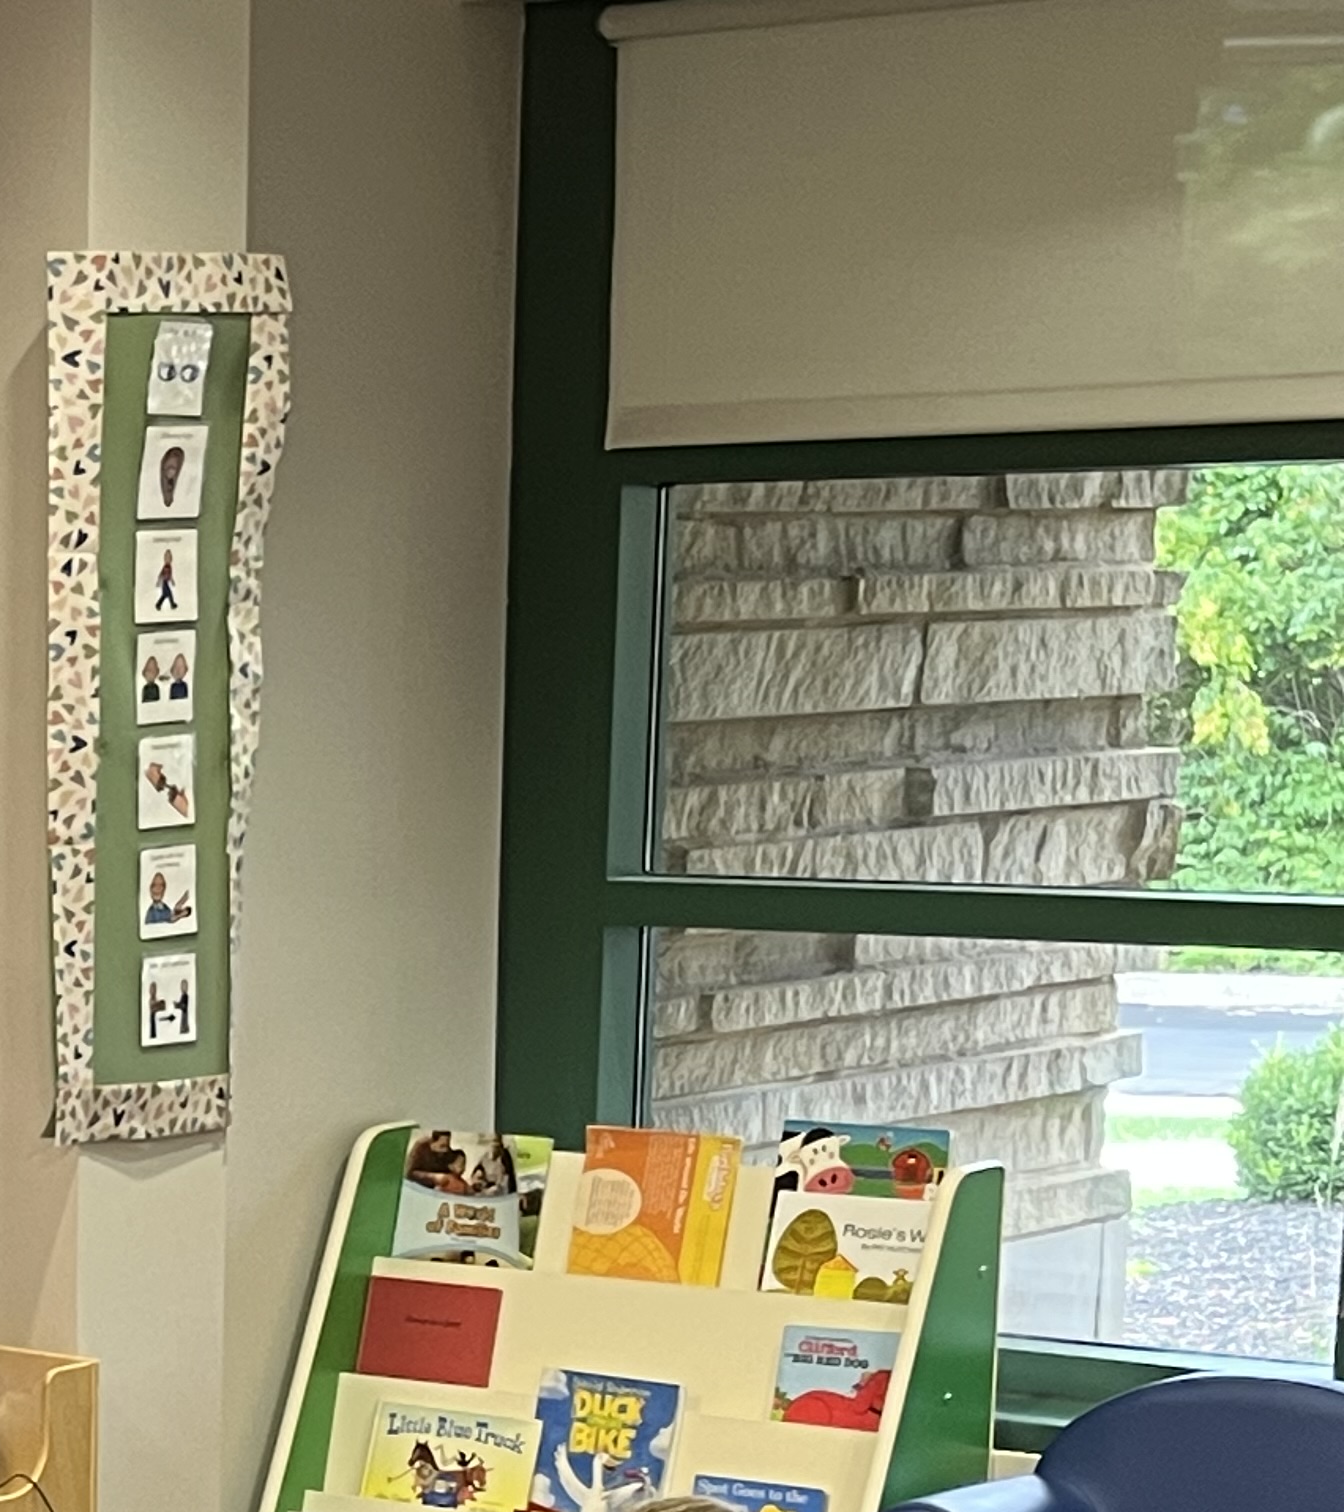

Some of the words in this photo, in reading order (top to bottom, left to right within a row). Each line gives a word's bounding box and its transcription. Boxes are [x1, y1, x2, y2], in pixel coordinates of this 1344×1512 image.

[842, 1223, 906, 1242] Rosie's
[386, 1412, 432, 1436] Little
[436, 1416, 473, 1438] Blue
[475, 1420, 527, 1455] Truck
[569, 1421, 637, 1459] BIKE
[768, 1489, 784, 1501] to
[785, 1489, 809, 1504] the
